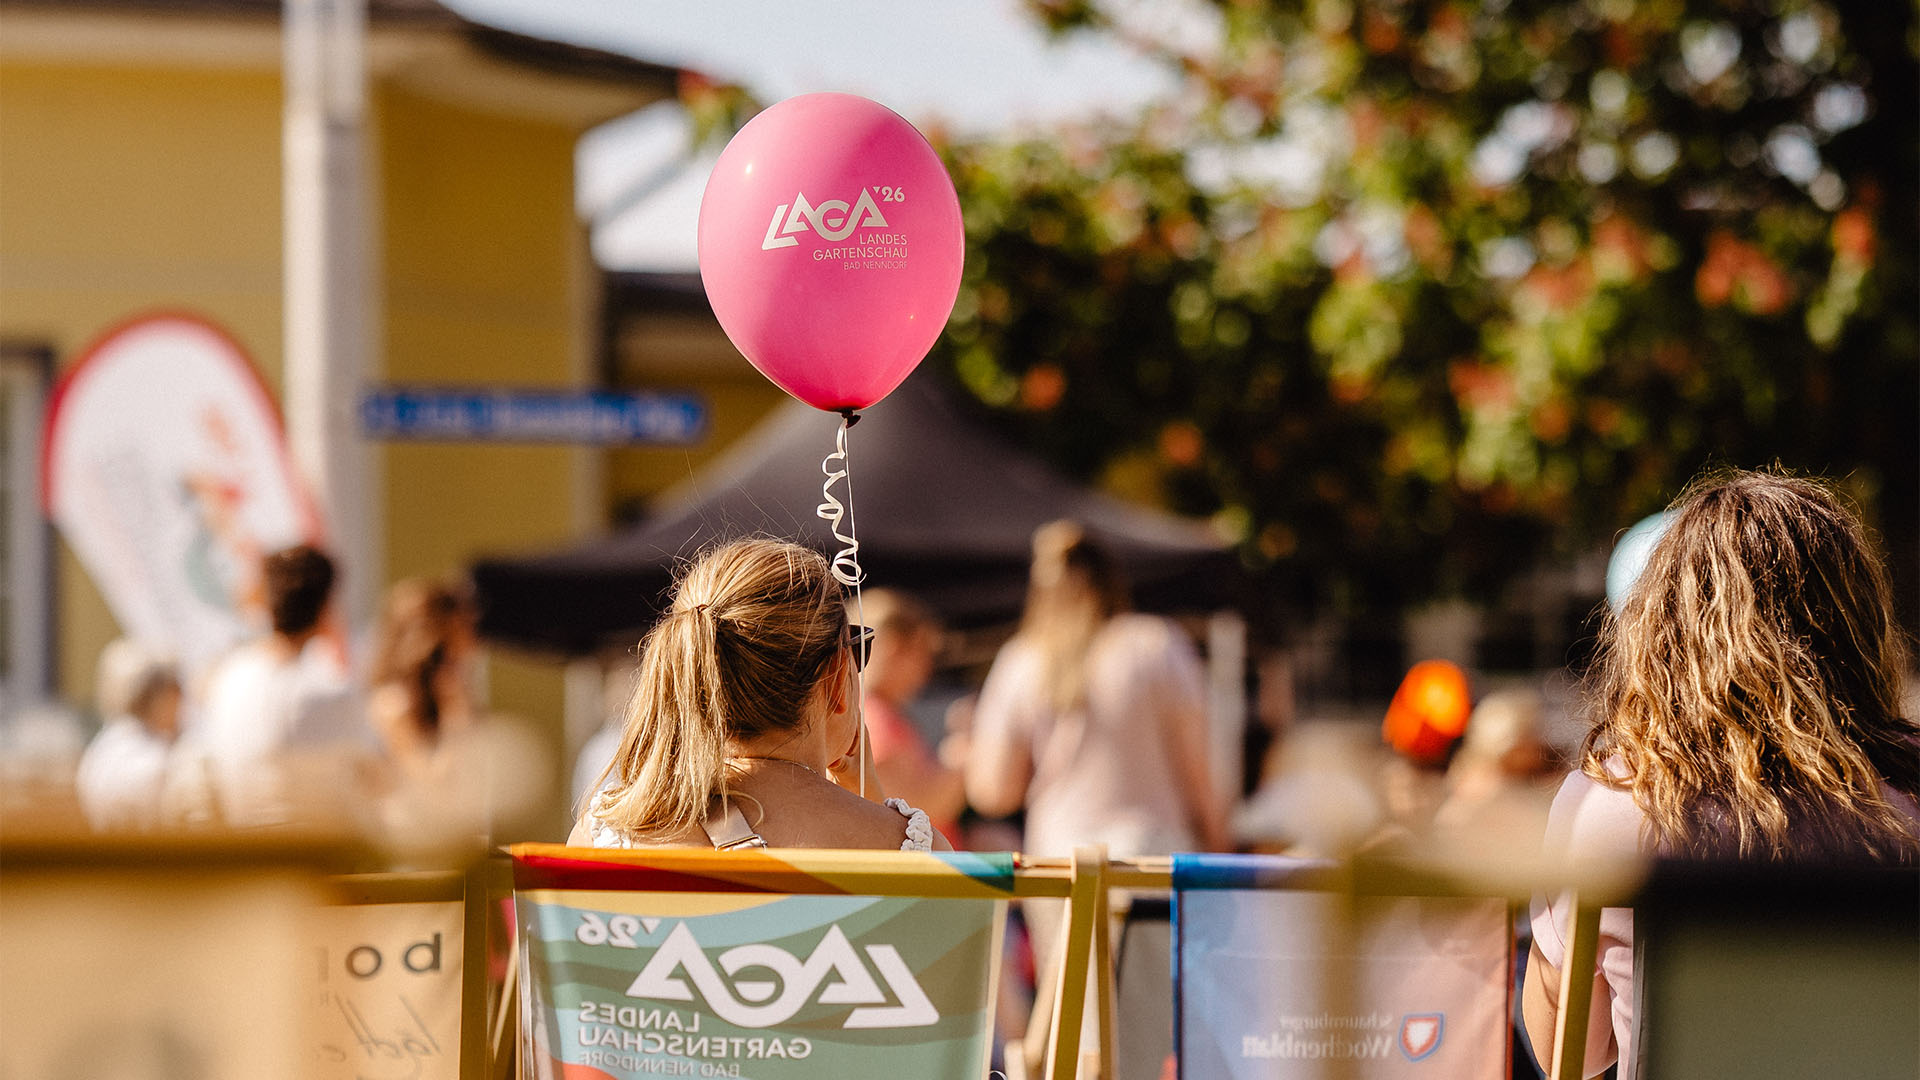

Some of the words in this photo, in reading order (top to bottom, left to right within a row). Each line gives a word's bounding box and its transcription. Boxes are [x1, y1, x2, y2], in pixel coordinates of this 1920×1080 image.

[761, 187, 889, 251] LAGA
[859, 233, 908, 246] LANDES
[812, 246, 909, 261] GARTENSCHAU
[843, 261, 861, 271] BAD
[863, 260, 908, 270] NENNDORF
